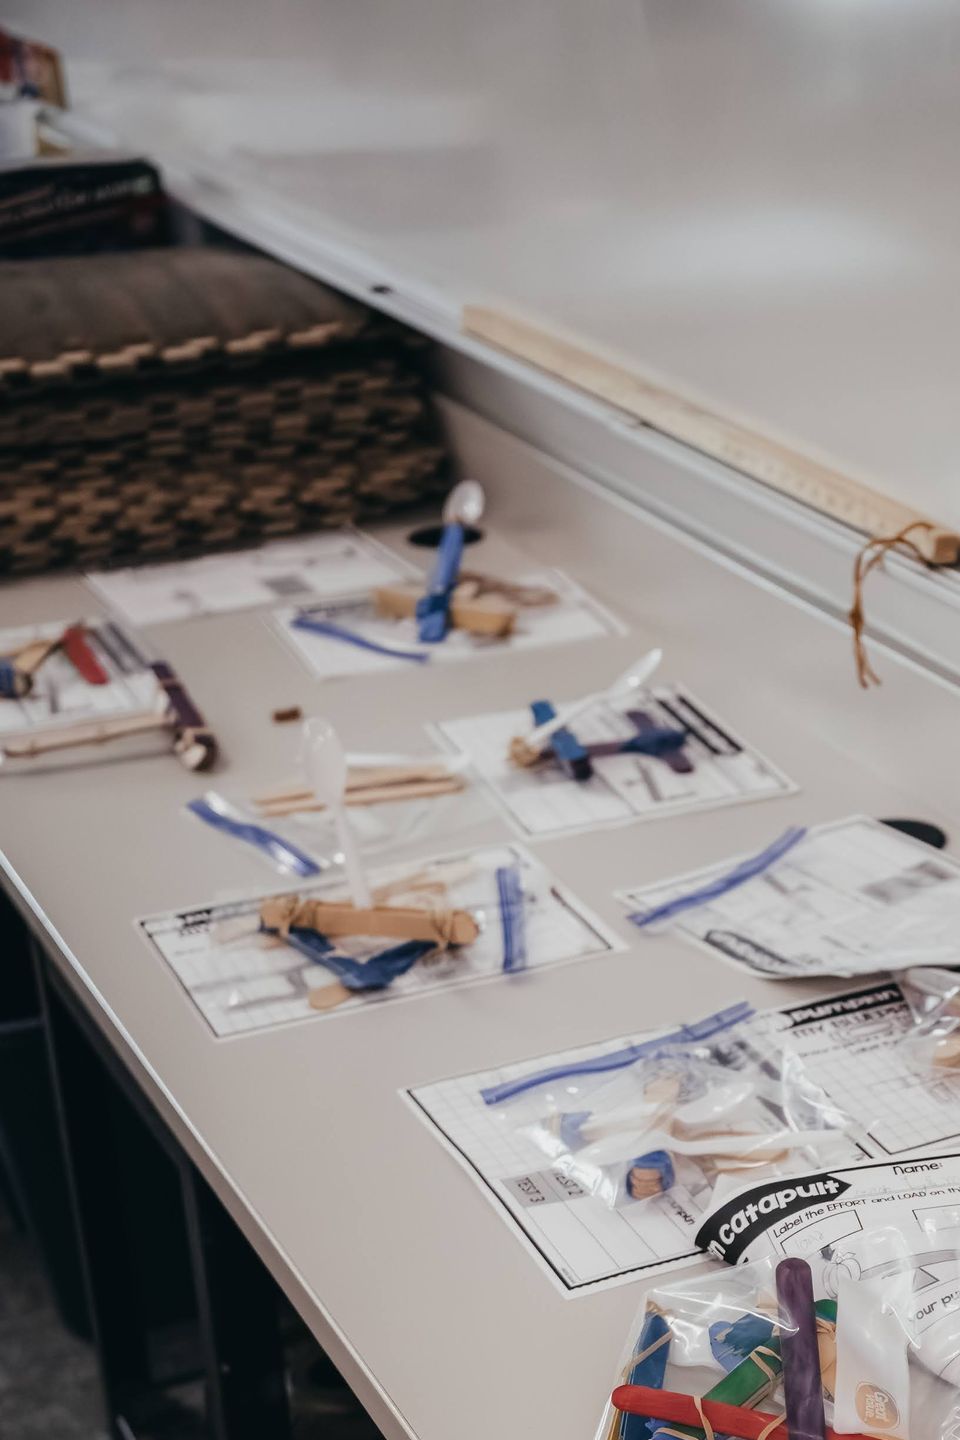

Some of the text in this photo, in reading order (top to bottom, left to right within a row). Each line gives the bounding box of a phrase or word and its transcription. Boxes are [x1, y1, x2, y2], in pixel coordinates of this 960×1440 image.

[892, 1161, 943, 1176] Name:
[719, 1180, 839, 1246] catapult
[773, 1215, 804, 1239] Label
[804, 1207, 825, 1221] the
[826, 1199, 867, 1213] EFFORT
[871, 1195, 895, 1204] and
[897, 1191, 927, 1201] LOAD
